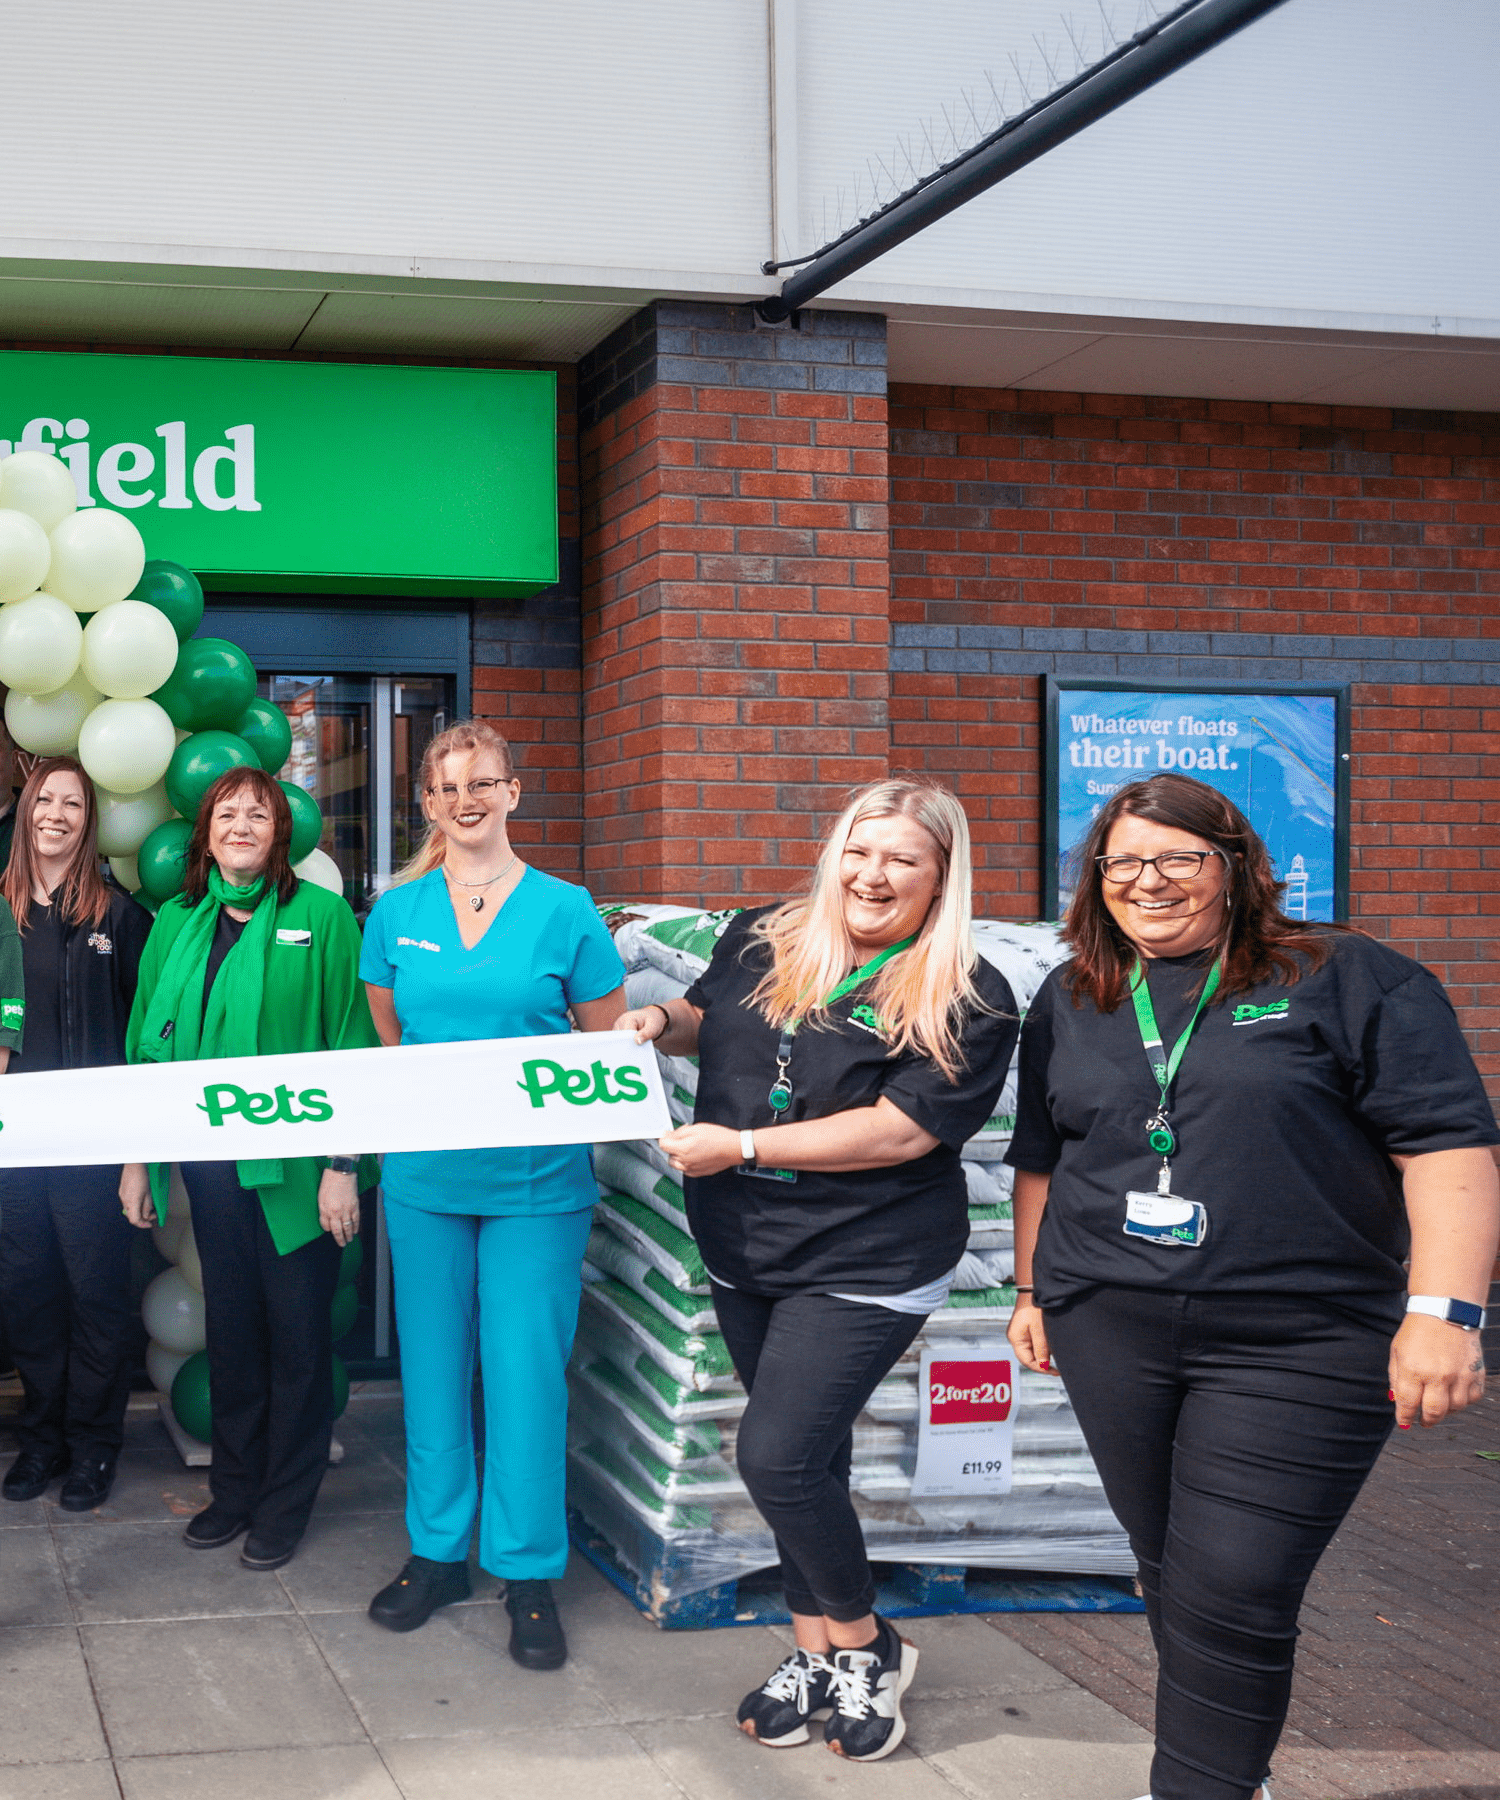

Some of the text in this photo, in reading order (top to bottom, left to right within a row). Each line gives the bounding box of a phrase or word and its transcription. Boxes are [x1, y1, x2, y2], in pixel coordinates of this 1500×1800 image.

[1070, 714, 1239, 737] Whatever floats
[1068, 738, 1239, 770] their boat.
[1231, 998, 1290, 1021] Pets
[516, 1059, 649, 1108] Pets
[196, 1083, 334, 1126] Pets
[1171, 1227, 1195, 1240] Pets
[961, 1460, 1003, 1475] £11.99
